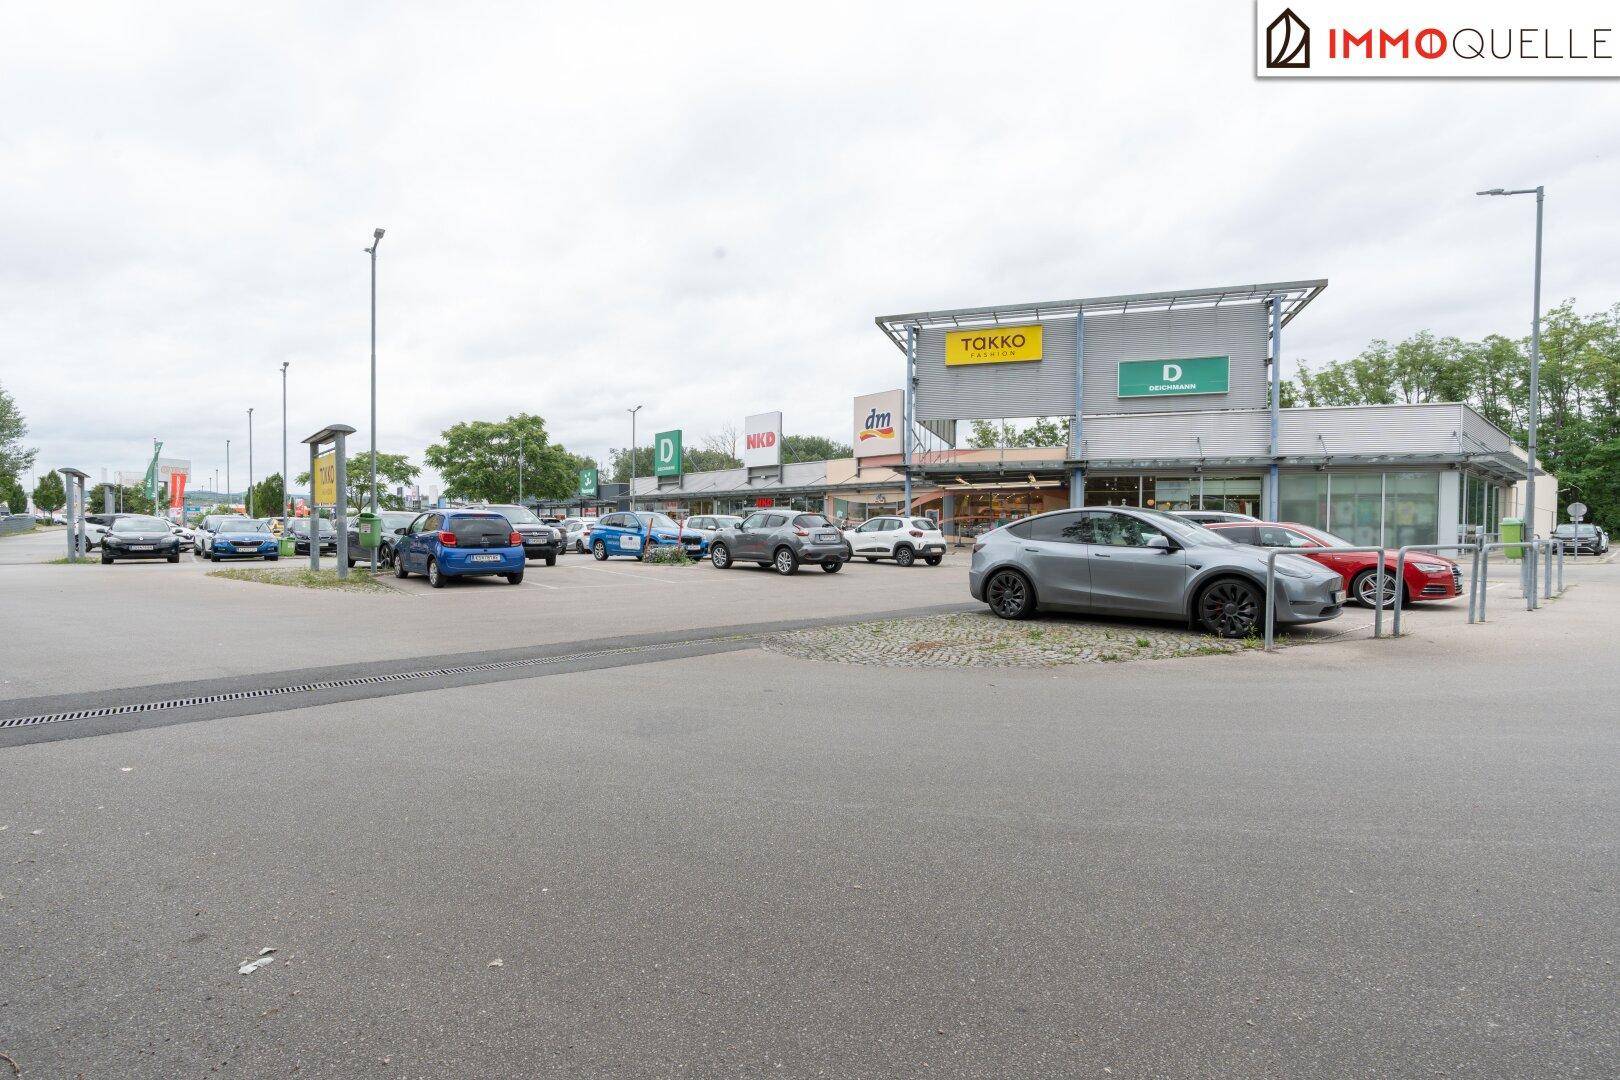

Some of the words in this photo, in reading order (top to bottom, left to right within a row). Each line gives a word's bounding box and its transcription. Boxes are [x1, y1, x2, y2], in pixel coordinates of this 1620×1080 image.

[970, 351, 1015, 359] FASHION
[1163, 364, 1183, 382] D
[1149, 383, 1196, 392] DEICHMANN
[865, 407, 891, 430] dm
[746, 431, 776, 450] NKD
[660, 438, 674, 463] D
